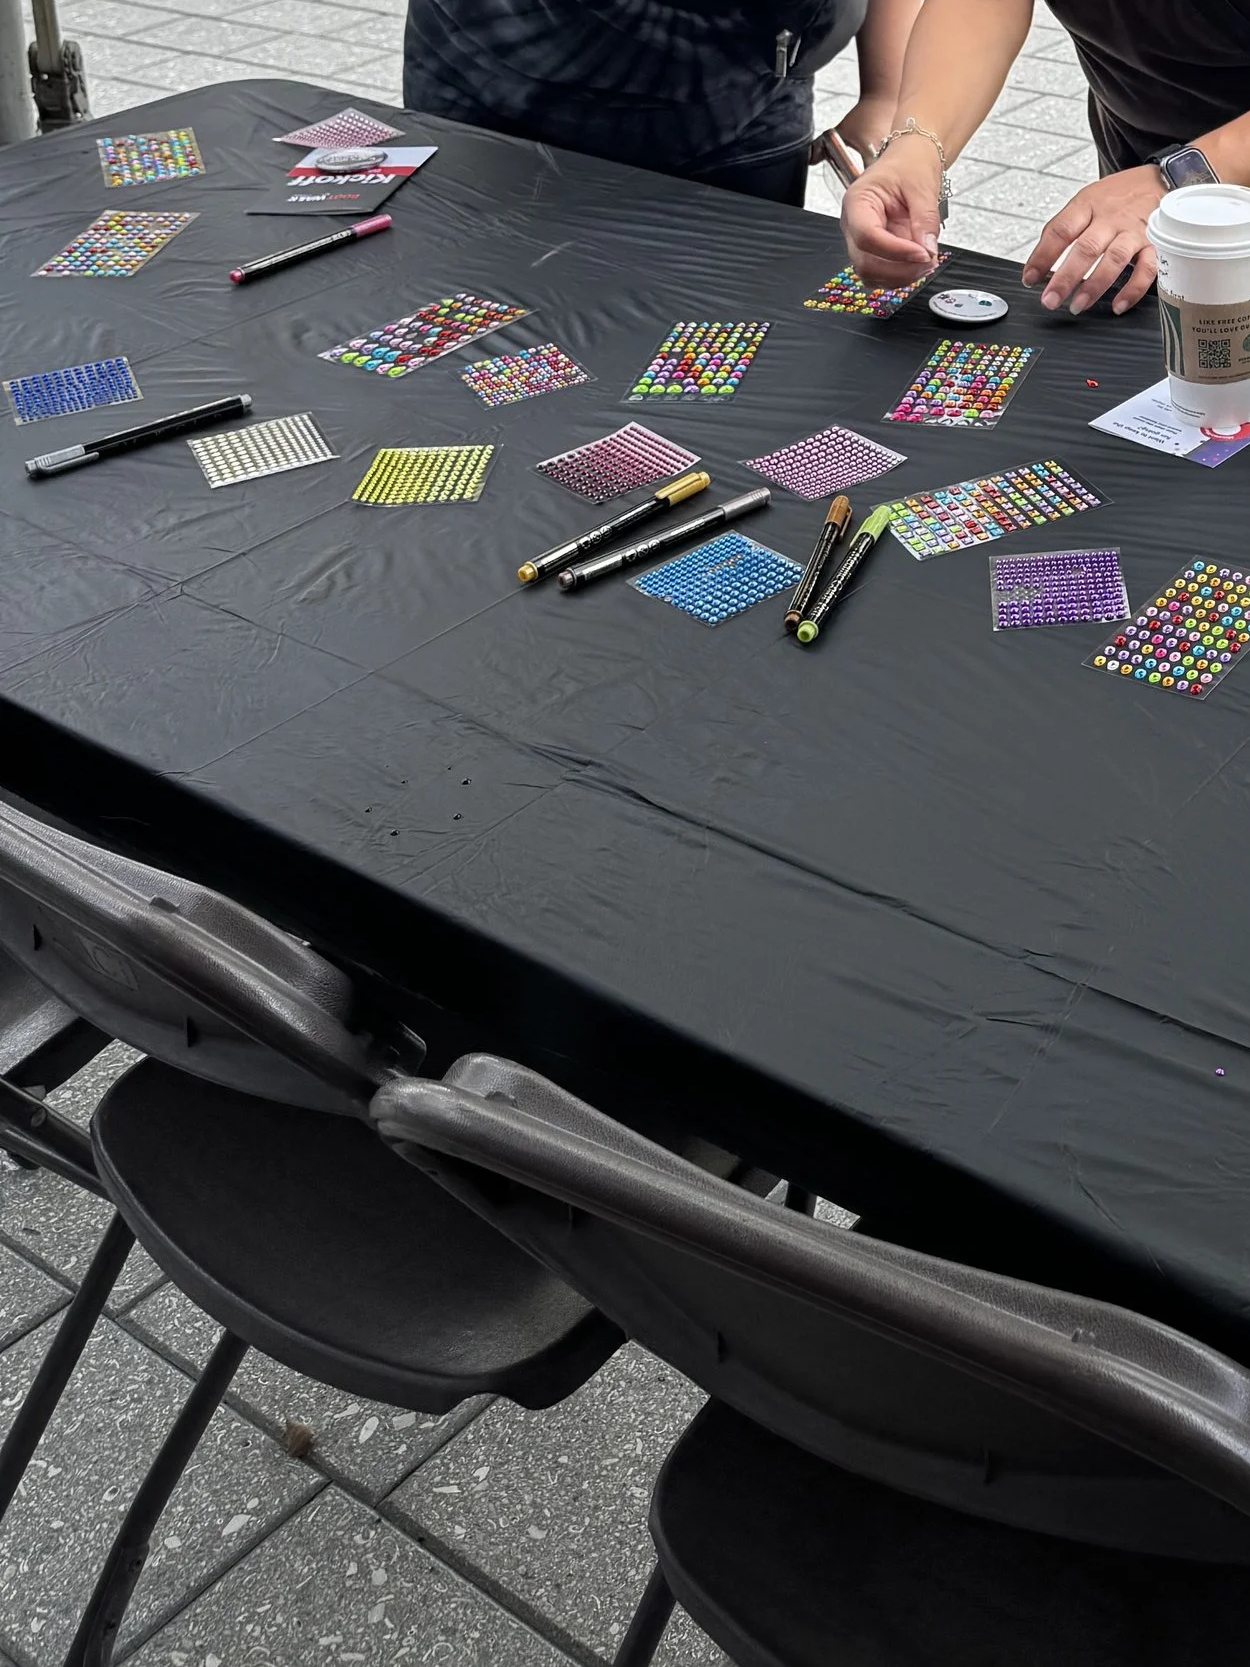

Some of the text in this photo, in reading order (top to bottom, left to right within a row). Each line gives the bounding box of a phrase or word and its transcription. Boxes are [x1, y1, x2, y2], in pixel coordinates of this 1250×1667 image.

[286, 173, 396, 186] Kickoff
[1199, 318, 1216, 326] LIKE
[1192, 326, 1217, 334] YOU'LL
[1220, 326, 1238, 334] LOVE
